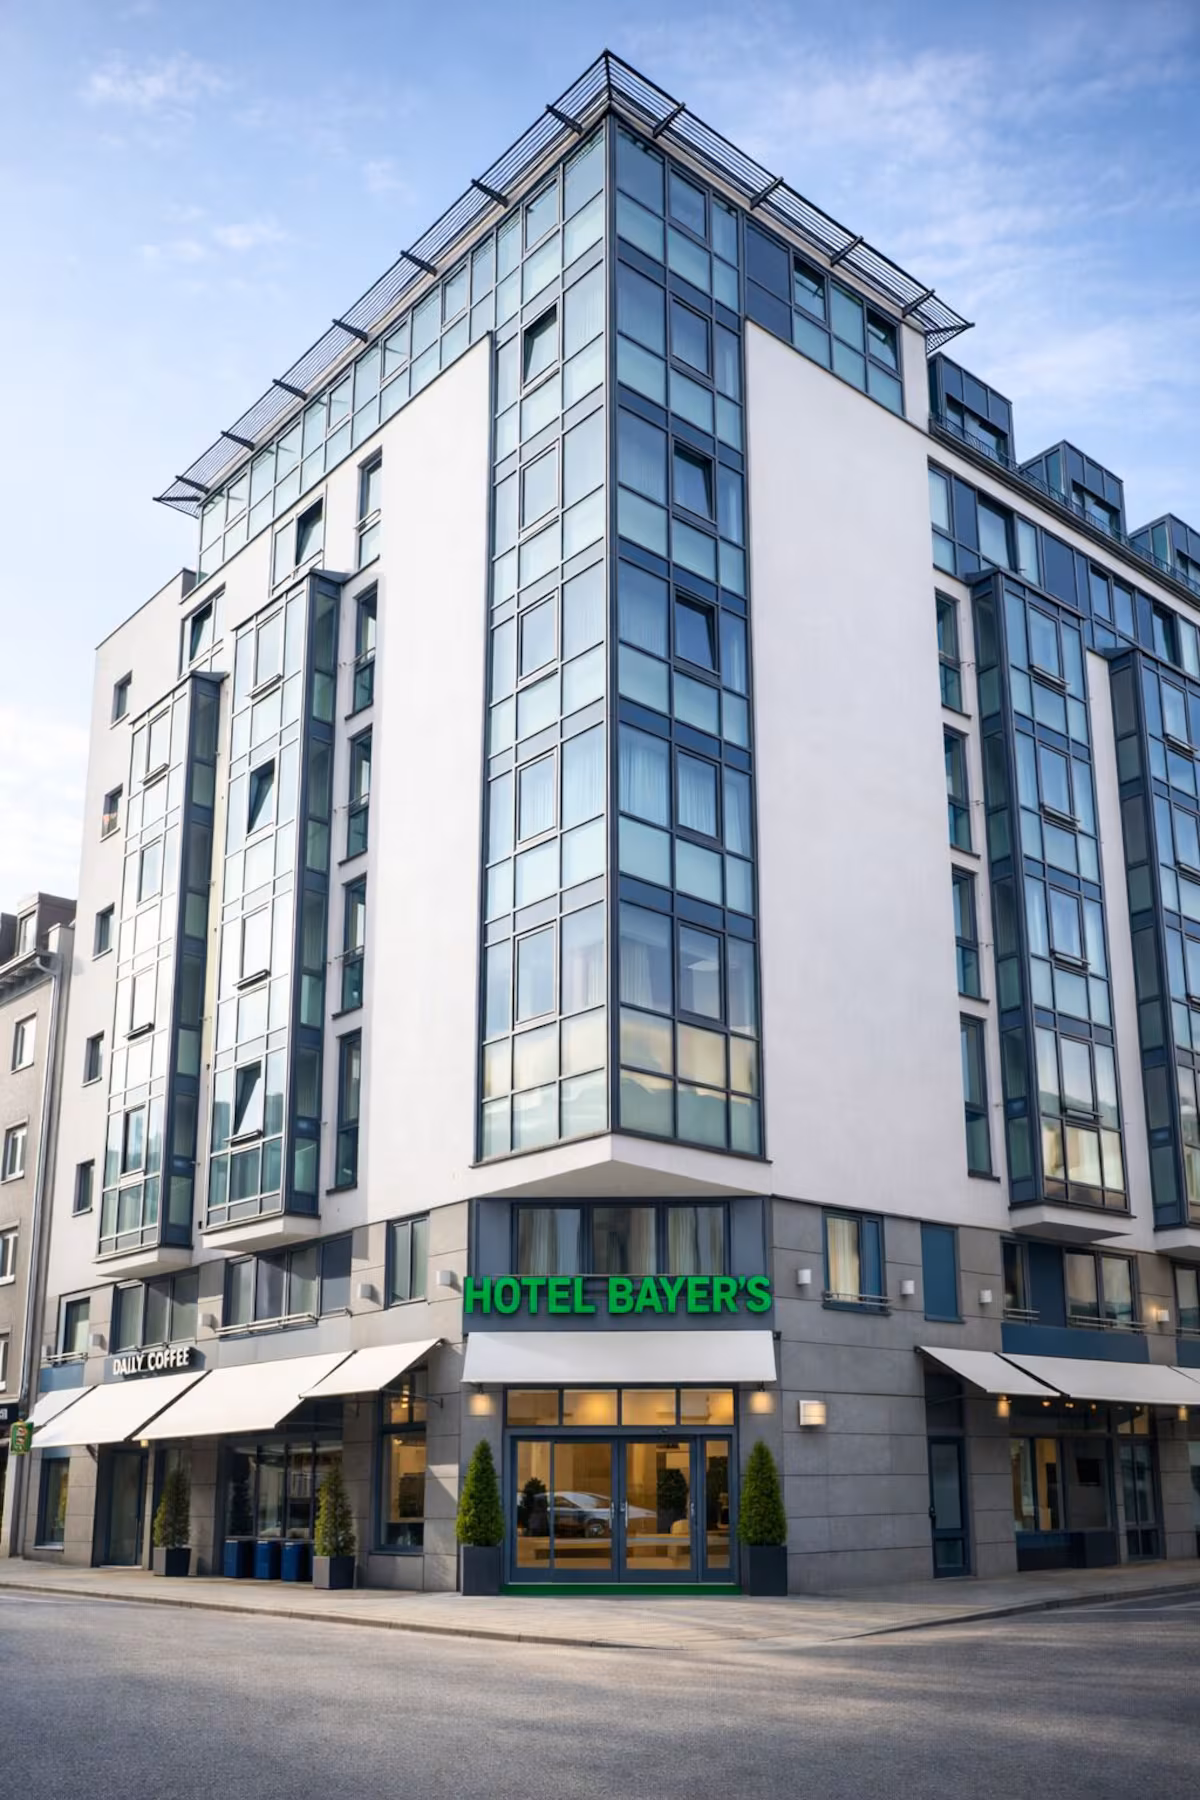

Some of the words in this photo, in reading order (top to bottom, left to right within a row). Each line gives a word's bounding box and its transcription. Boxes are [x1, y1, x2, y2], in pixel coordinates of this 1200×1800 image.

[463, 1275, 597, 1314] HOTEL
[608, 1275, 772, 1314] BAYER'S
[112, 1354, 145, 1375] DAILY
[147, 1346, 190, 1371] COFFEE
